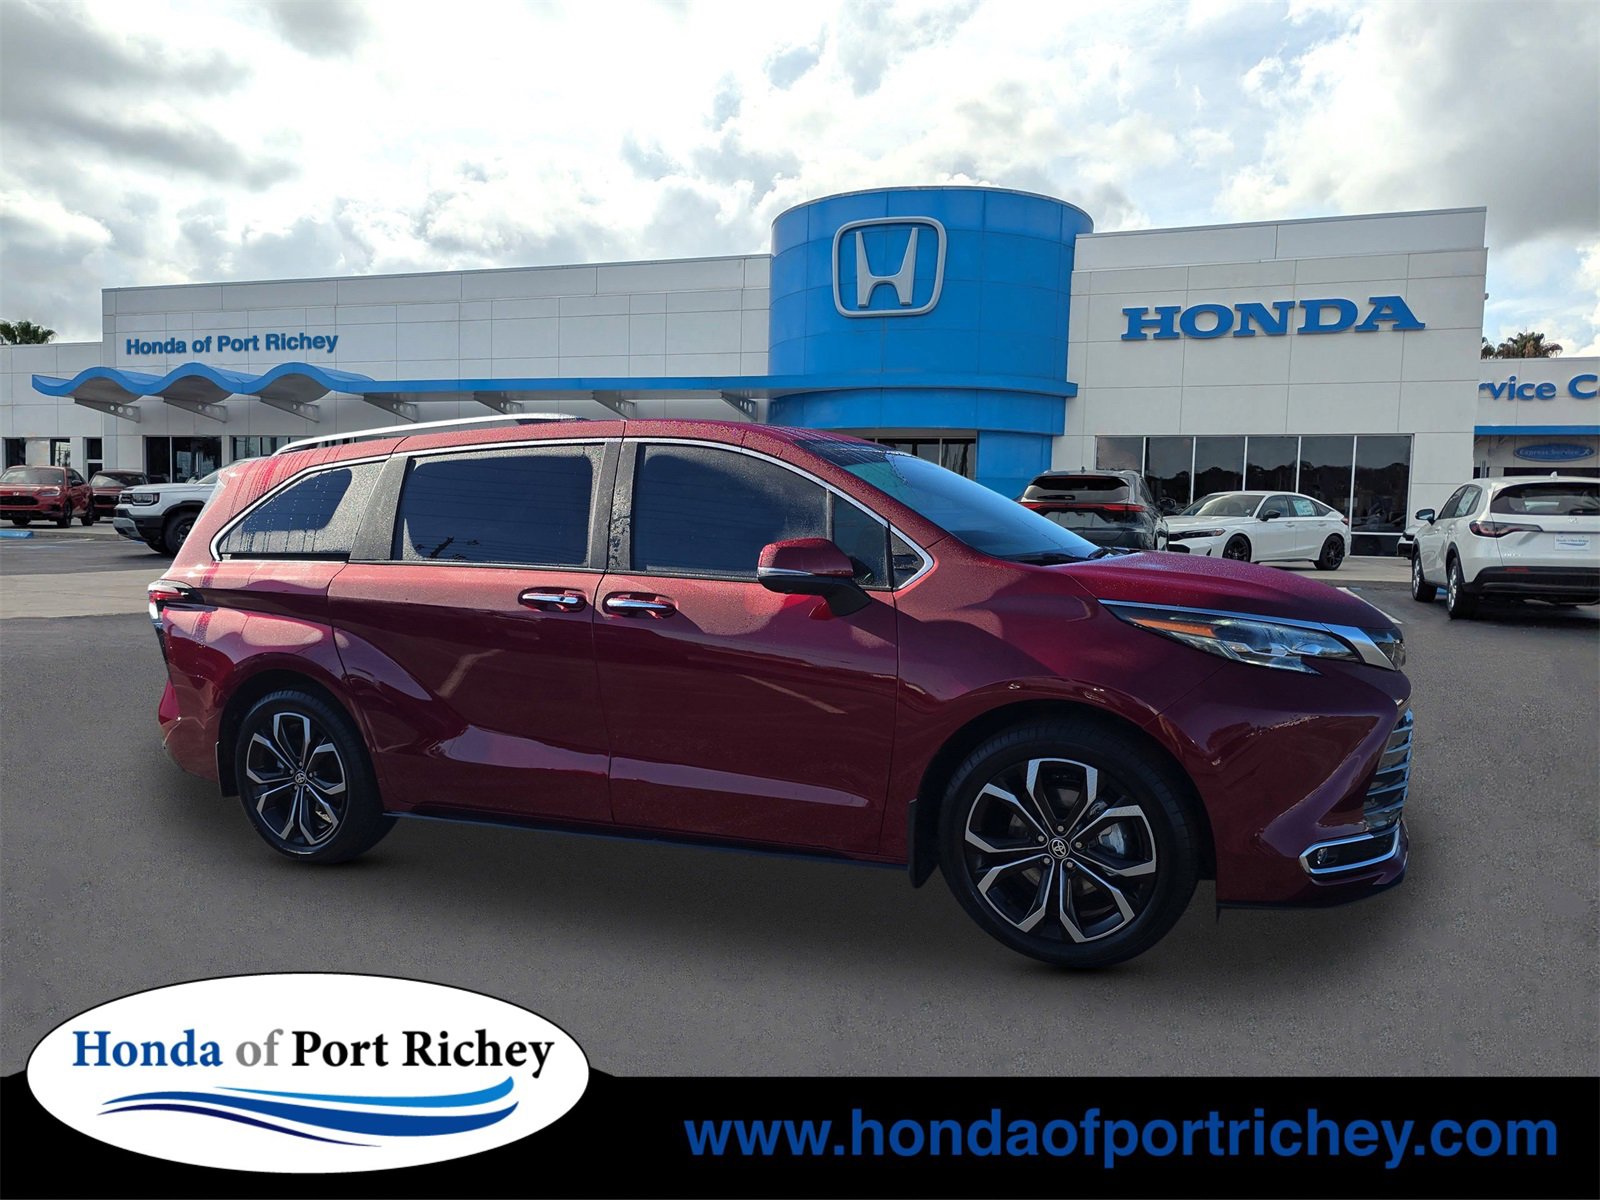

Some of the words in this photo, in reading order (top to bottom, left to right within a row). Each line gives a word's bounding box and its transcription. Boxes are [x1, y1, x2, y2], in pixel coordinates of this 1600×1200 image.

[1121, 295, 1426, 341] HONDA
[126, 337, 187, 356] Honda
[191, 335, 212, 354] of
[217, 335, 260, 353] Port
[265, 332, 339, 354] Richey
